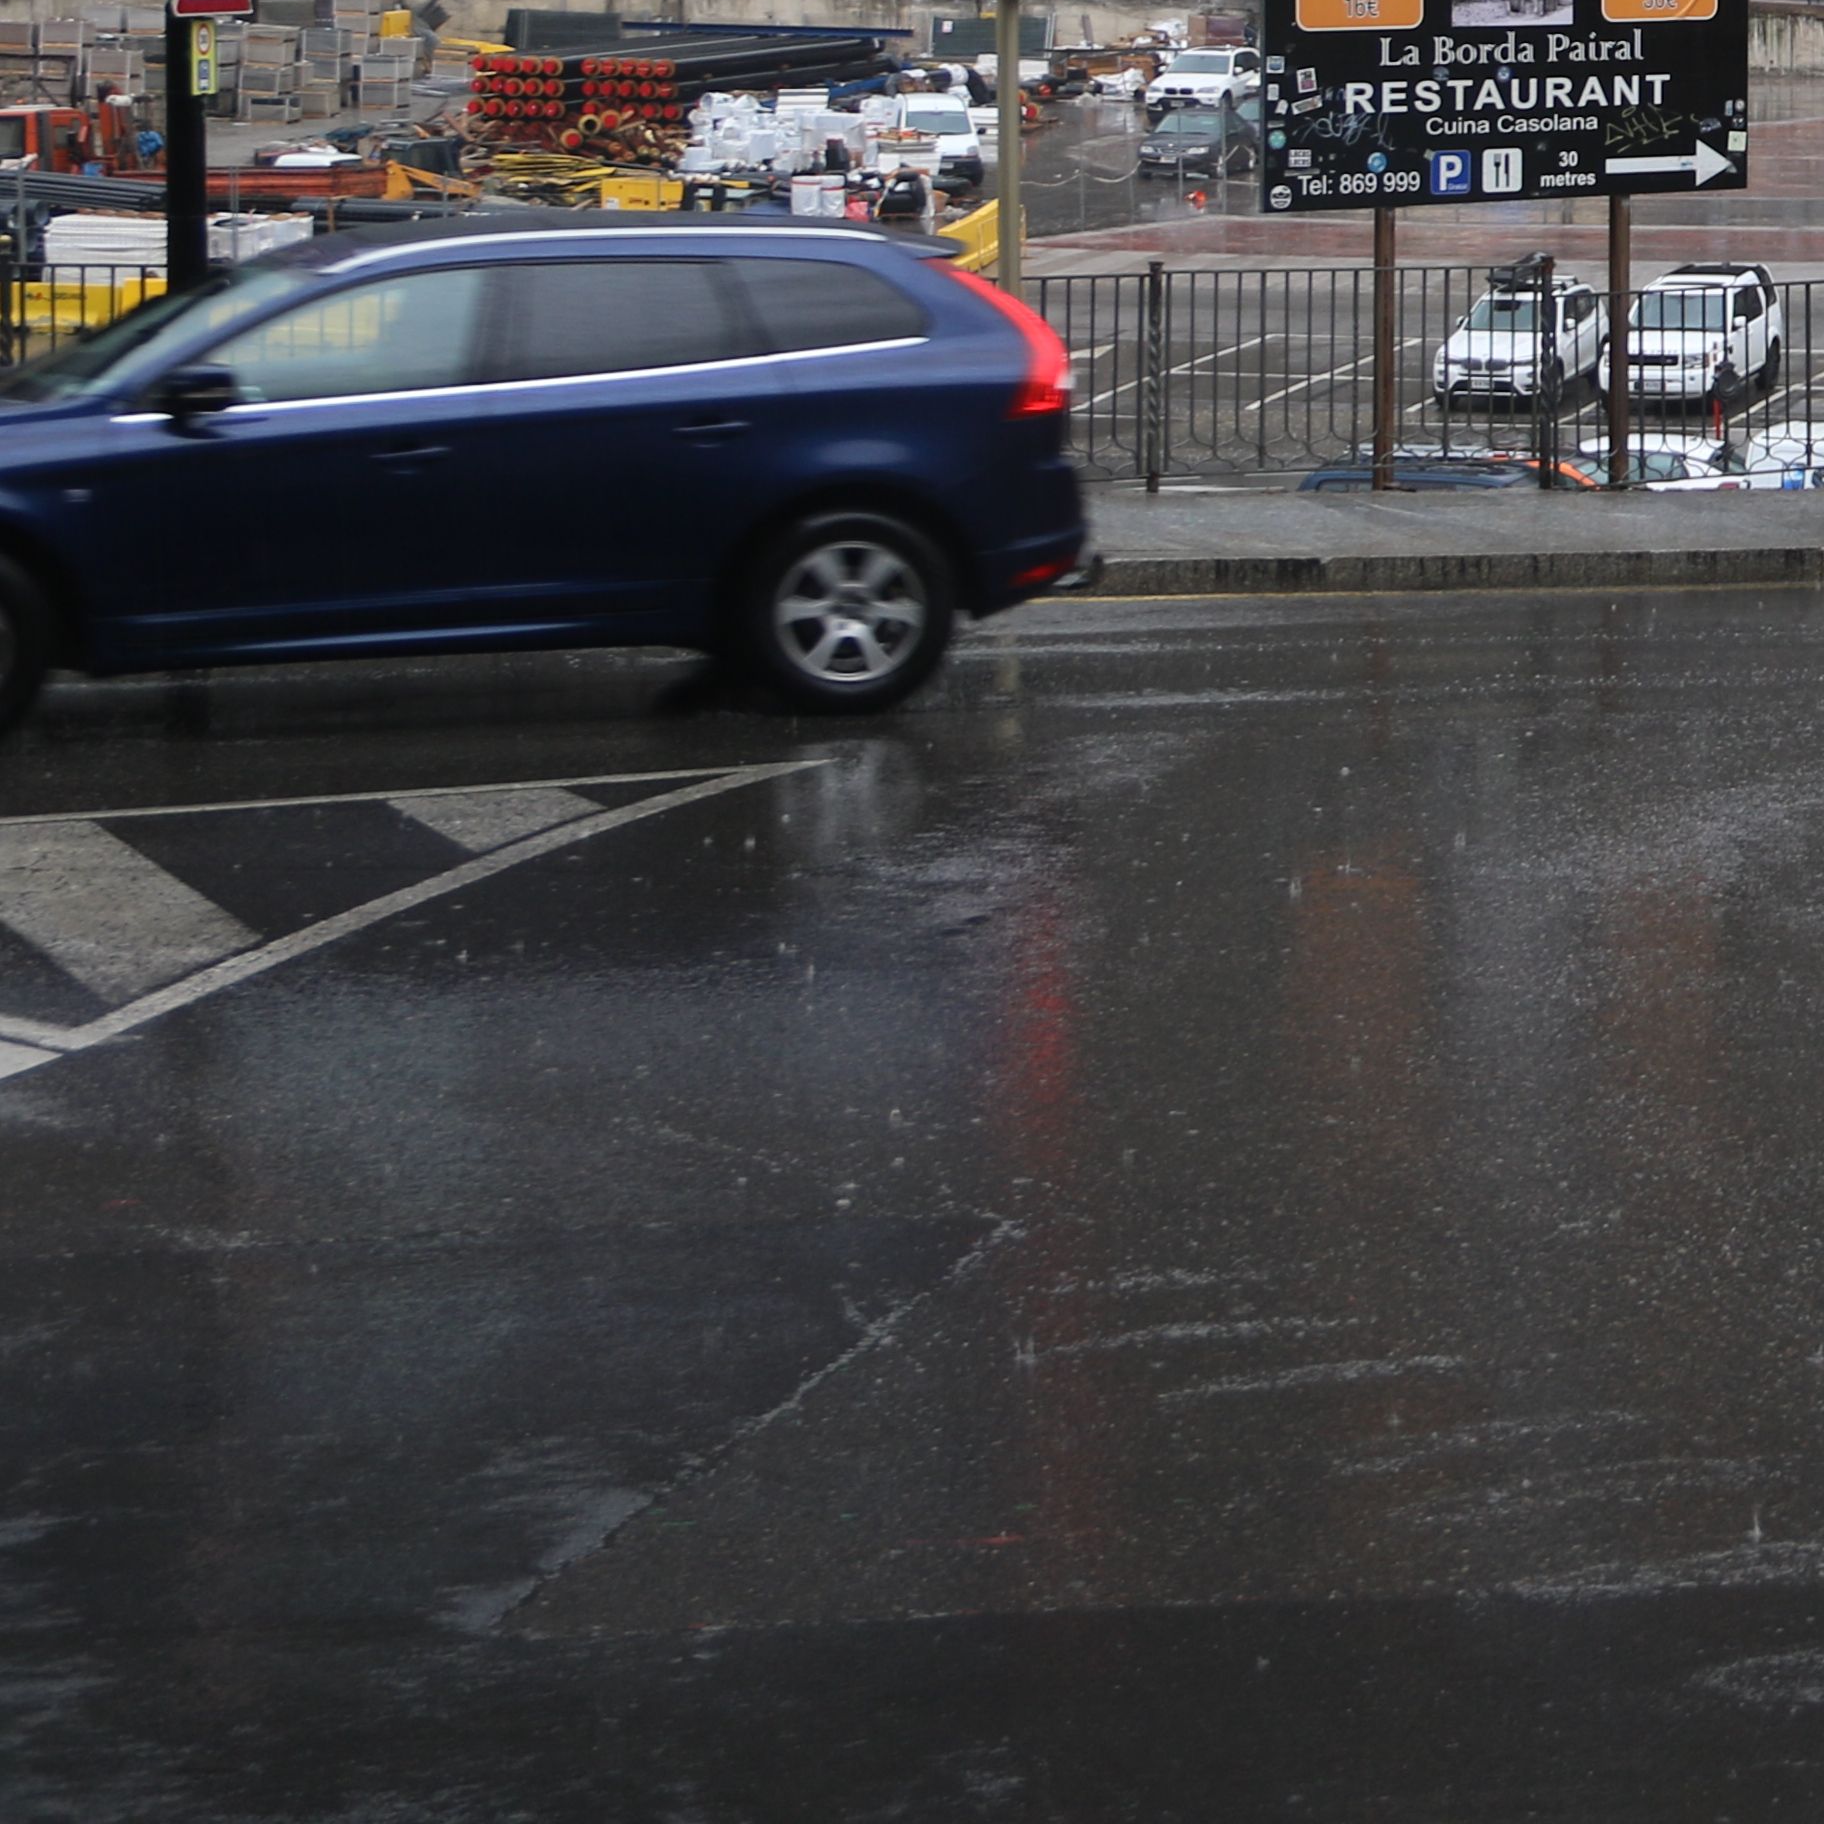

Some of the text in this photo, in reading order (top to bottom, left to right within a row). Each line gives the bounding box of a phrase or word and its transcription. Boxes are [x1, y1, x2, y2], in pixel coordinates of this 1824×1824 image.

[1379, 28, 1645, 66] La Borda Pairal
[1344, 74, 1671, 114] RESTAURANT
[1426, 116, 1490, 135] Cuina
[1497, 114, 1599, 133] Casolana
[1558, 150, 1579, 167] 30
[1297, 171, 1421, 196] Tel: 869 999
[1439, 154, 1463, 191] P
[1540, 171, 1596, 187] metres
